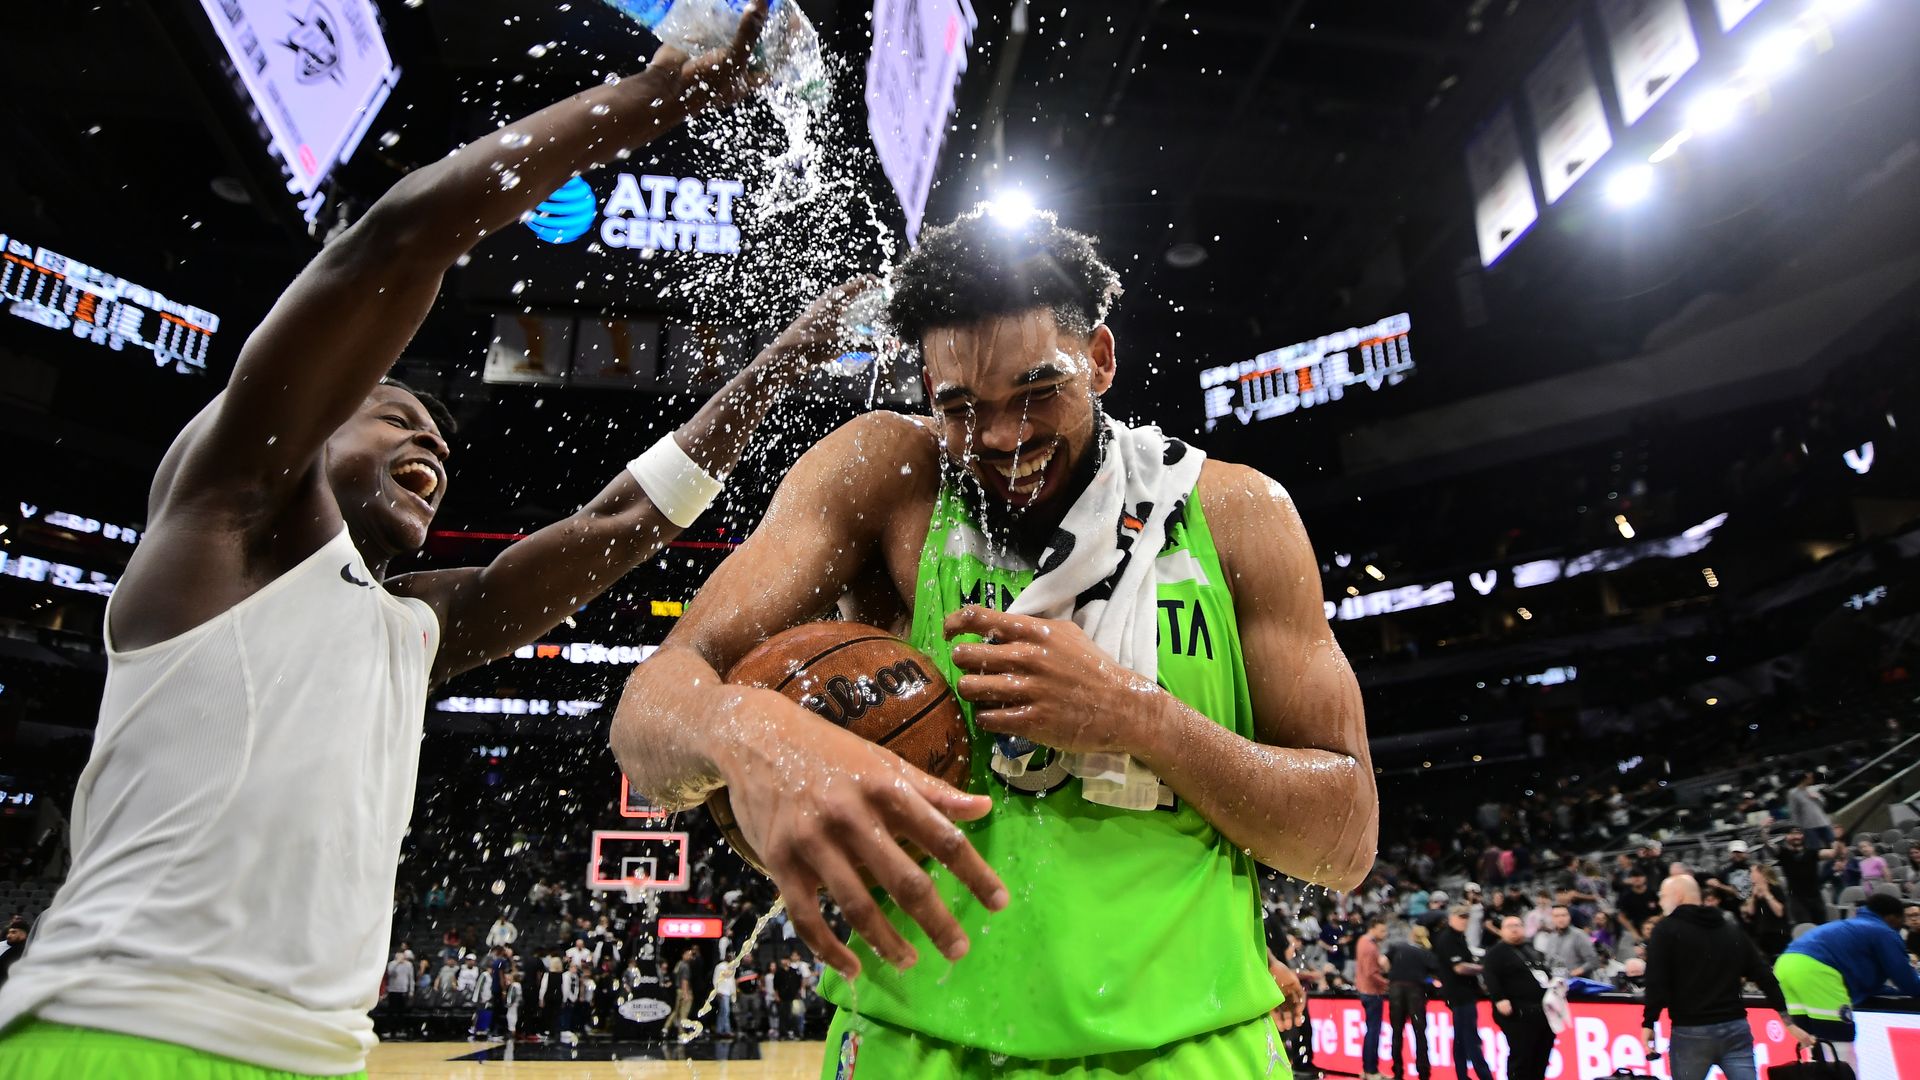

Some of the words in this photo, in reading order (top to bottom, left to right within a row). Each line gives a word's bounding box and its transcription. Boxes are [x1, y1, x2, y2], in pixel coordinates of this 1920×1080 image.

[603, 173, 745, 224] AT&T
[600, 216, 741, 254] CENTER
[808, 658, 932, 728] ilson
